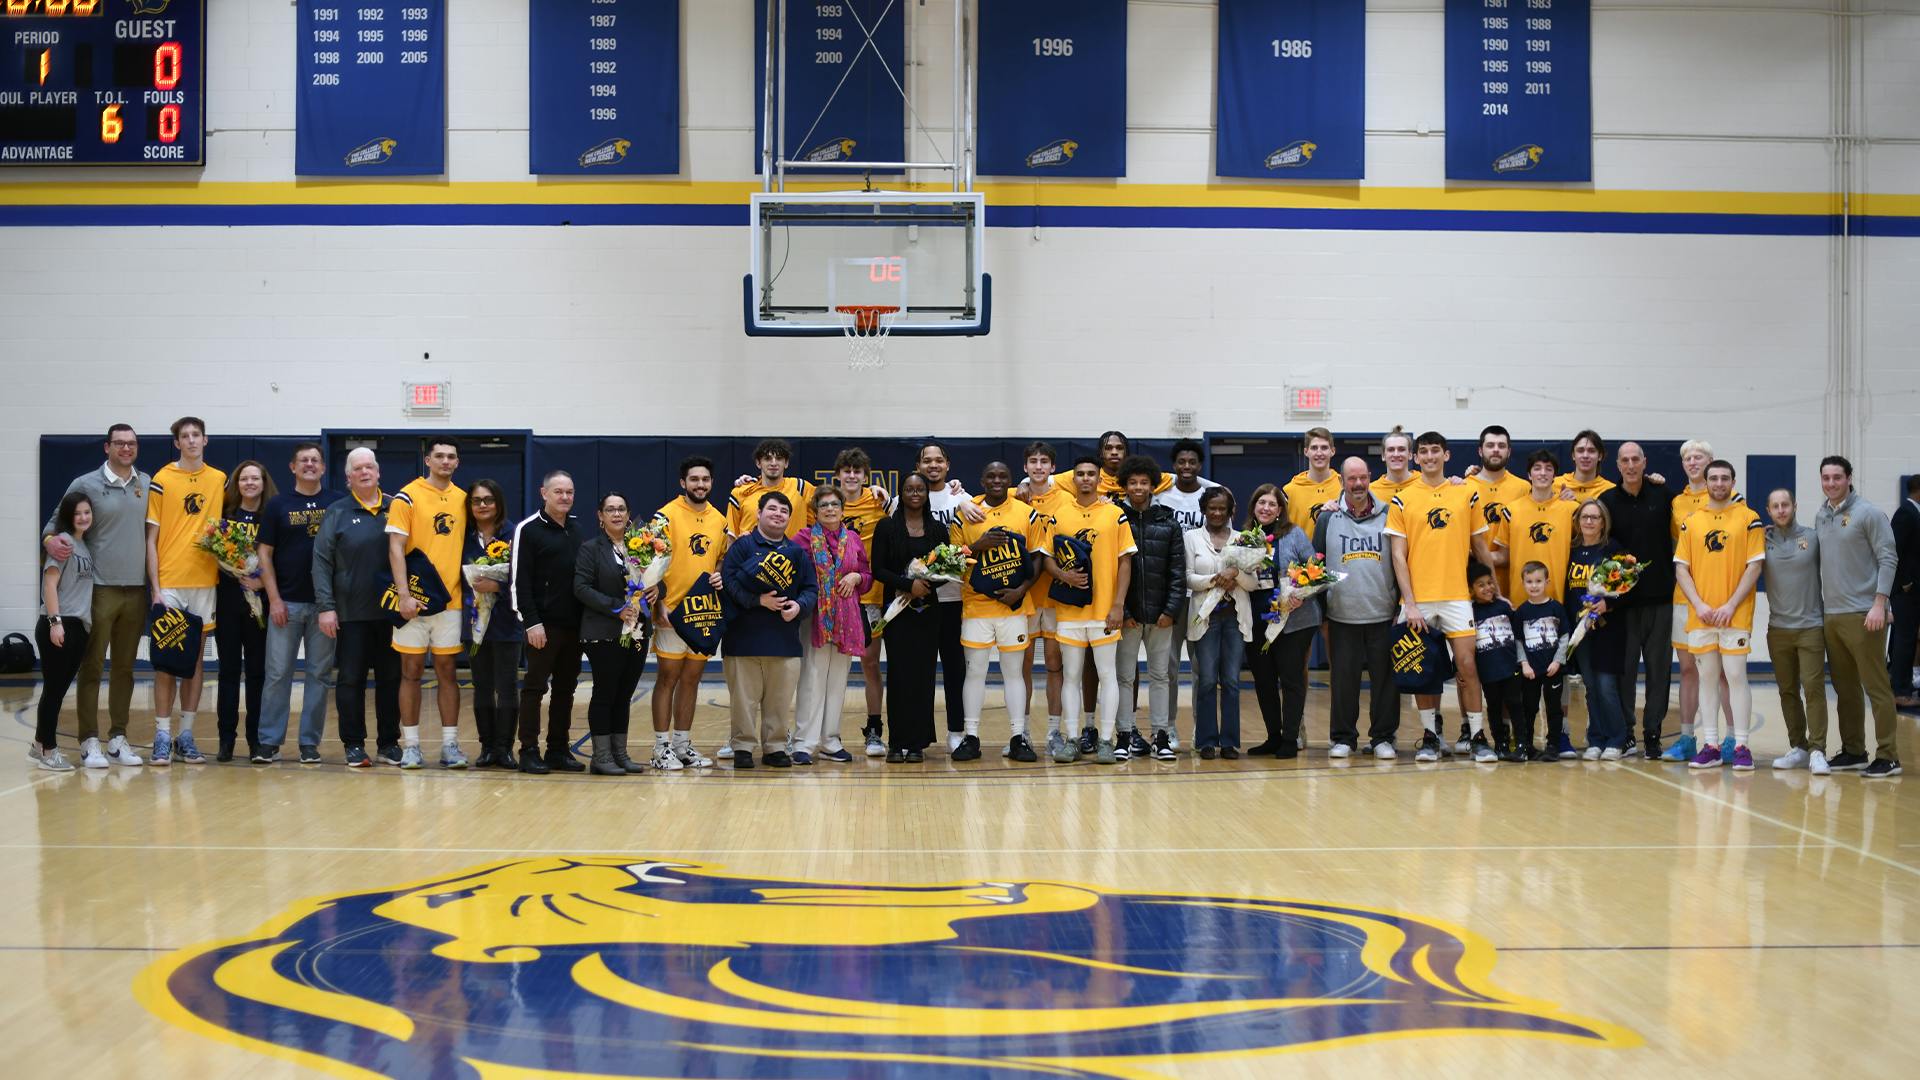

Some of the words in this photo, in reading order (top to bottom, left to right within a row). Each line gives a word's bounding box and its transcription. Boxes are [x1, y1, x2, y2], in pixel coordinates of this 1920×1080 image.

[314, 8, 338, 20] 1991
[358, 8, 384, 20] 1992
[402, 8, 428, 20] 1993
[816, 6, 842, 17] 1993
[590, 15, 616, 26] 1987
[1483, 18, 1508, 29] 1985
[1526, 18, 1552, 30] 1988
[116, 20, 176, 38] GUEST
[816, 28, 842, 40] 1994
[14, 32, 60, 44] PERIOD
[314, 30, 340, 42] 1994
[358, 30, 384, 42] 1995
[402, 30, 428, 42] 1996
[590, 38, 616, 50] 1989
[1032, 38, 1074, 56] 1996
[1271, 40, 1312, 58] 1986
[1483, 39, 1508, 50] 1990
[1526, 40, 1551, 52] 1991
[314, 52, 340, 64] 1998
[356, 52, 384, 64] 2000
[400, 52, 428, 64] 2005
[816, 52, 842, 64] 2000
[40, 48, 51, 86] 1
[155, 42, 182, 90] 0
[590, 62, 616, 74] 1992
[1483, 60, 1508, 72] 1995
[1526, 62, 1552, 74] 1996
[313, 74, 340, 86] 2006
[590, 84, 616, 97] 1994
[1483, 82, 1508, 94] 1999
[1525, 83, 1550, 94] 2011
[0, 92, 24, 104] OUL
[30, 92, 78, 104] PLAYER
[95, 92, 128, 104] T.O.L.
[144, 92, 184, 104] FOULS
[590, 108, 616, 120] 1996
[1483, 104, 1508, 116] 2014
[102, 104, 123, 144] 6
[160, 104, 181, 143] 0
[1, 146, 73, 158] ADVANTAGE
[144, 146, 184, 158] SCORE
[414, 384, 438, 404] EXIT
[1297, 388, 1321, 408] EXIT
[1174, 510, 1204, 528] CNJ
[1339, 531, 1382, 554] TCNJ
[982, 561, 1022, 576] BASKETBALL
[1002, 576, 1009, 586] 5
[684, 614, 722, 624] BASKETBALL
[158, 622, 190, 649] BASKETBALL
[702, 627, 710, 636] 12
